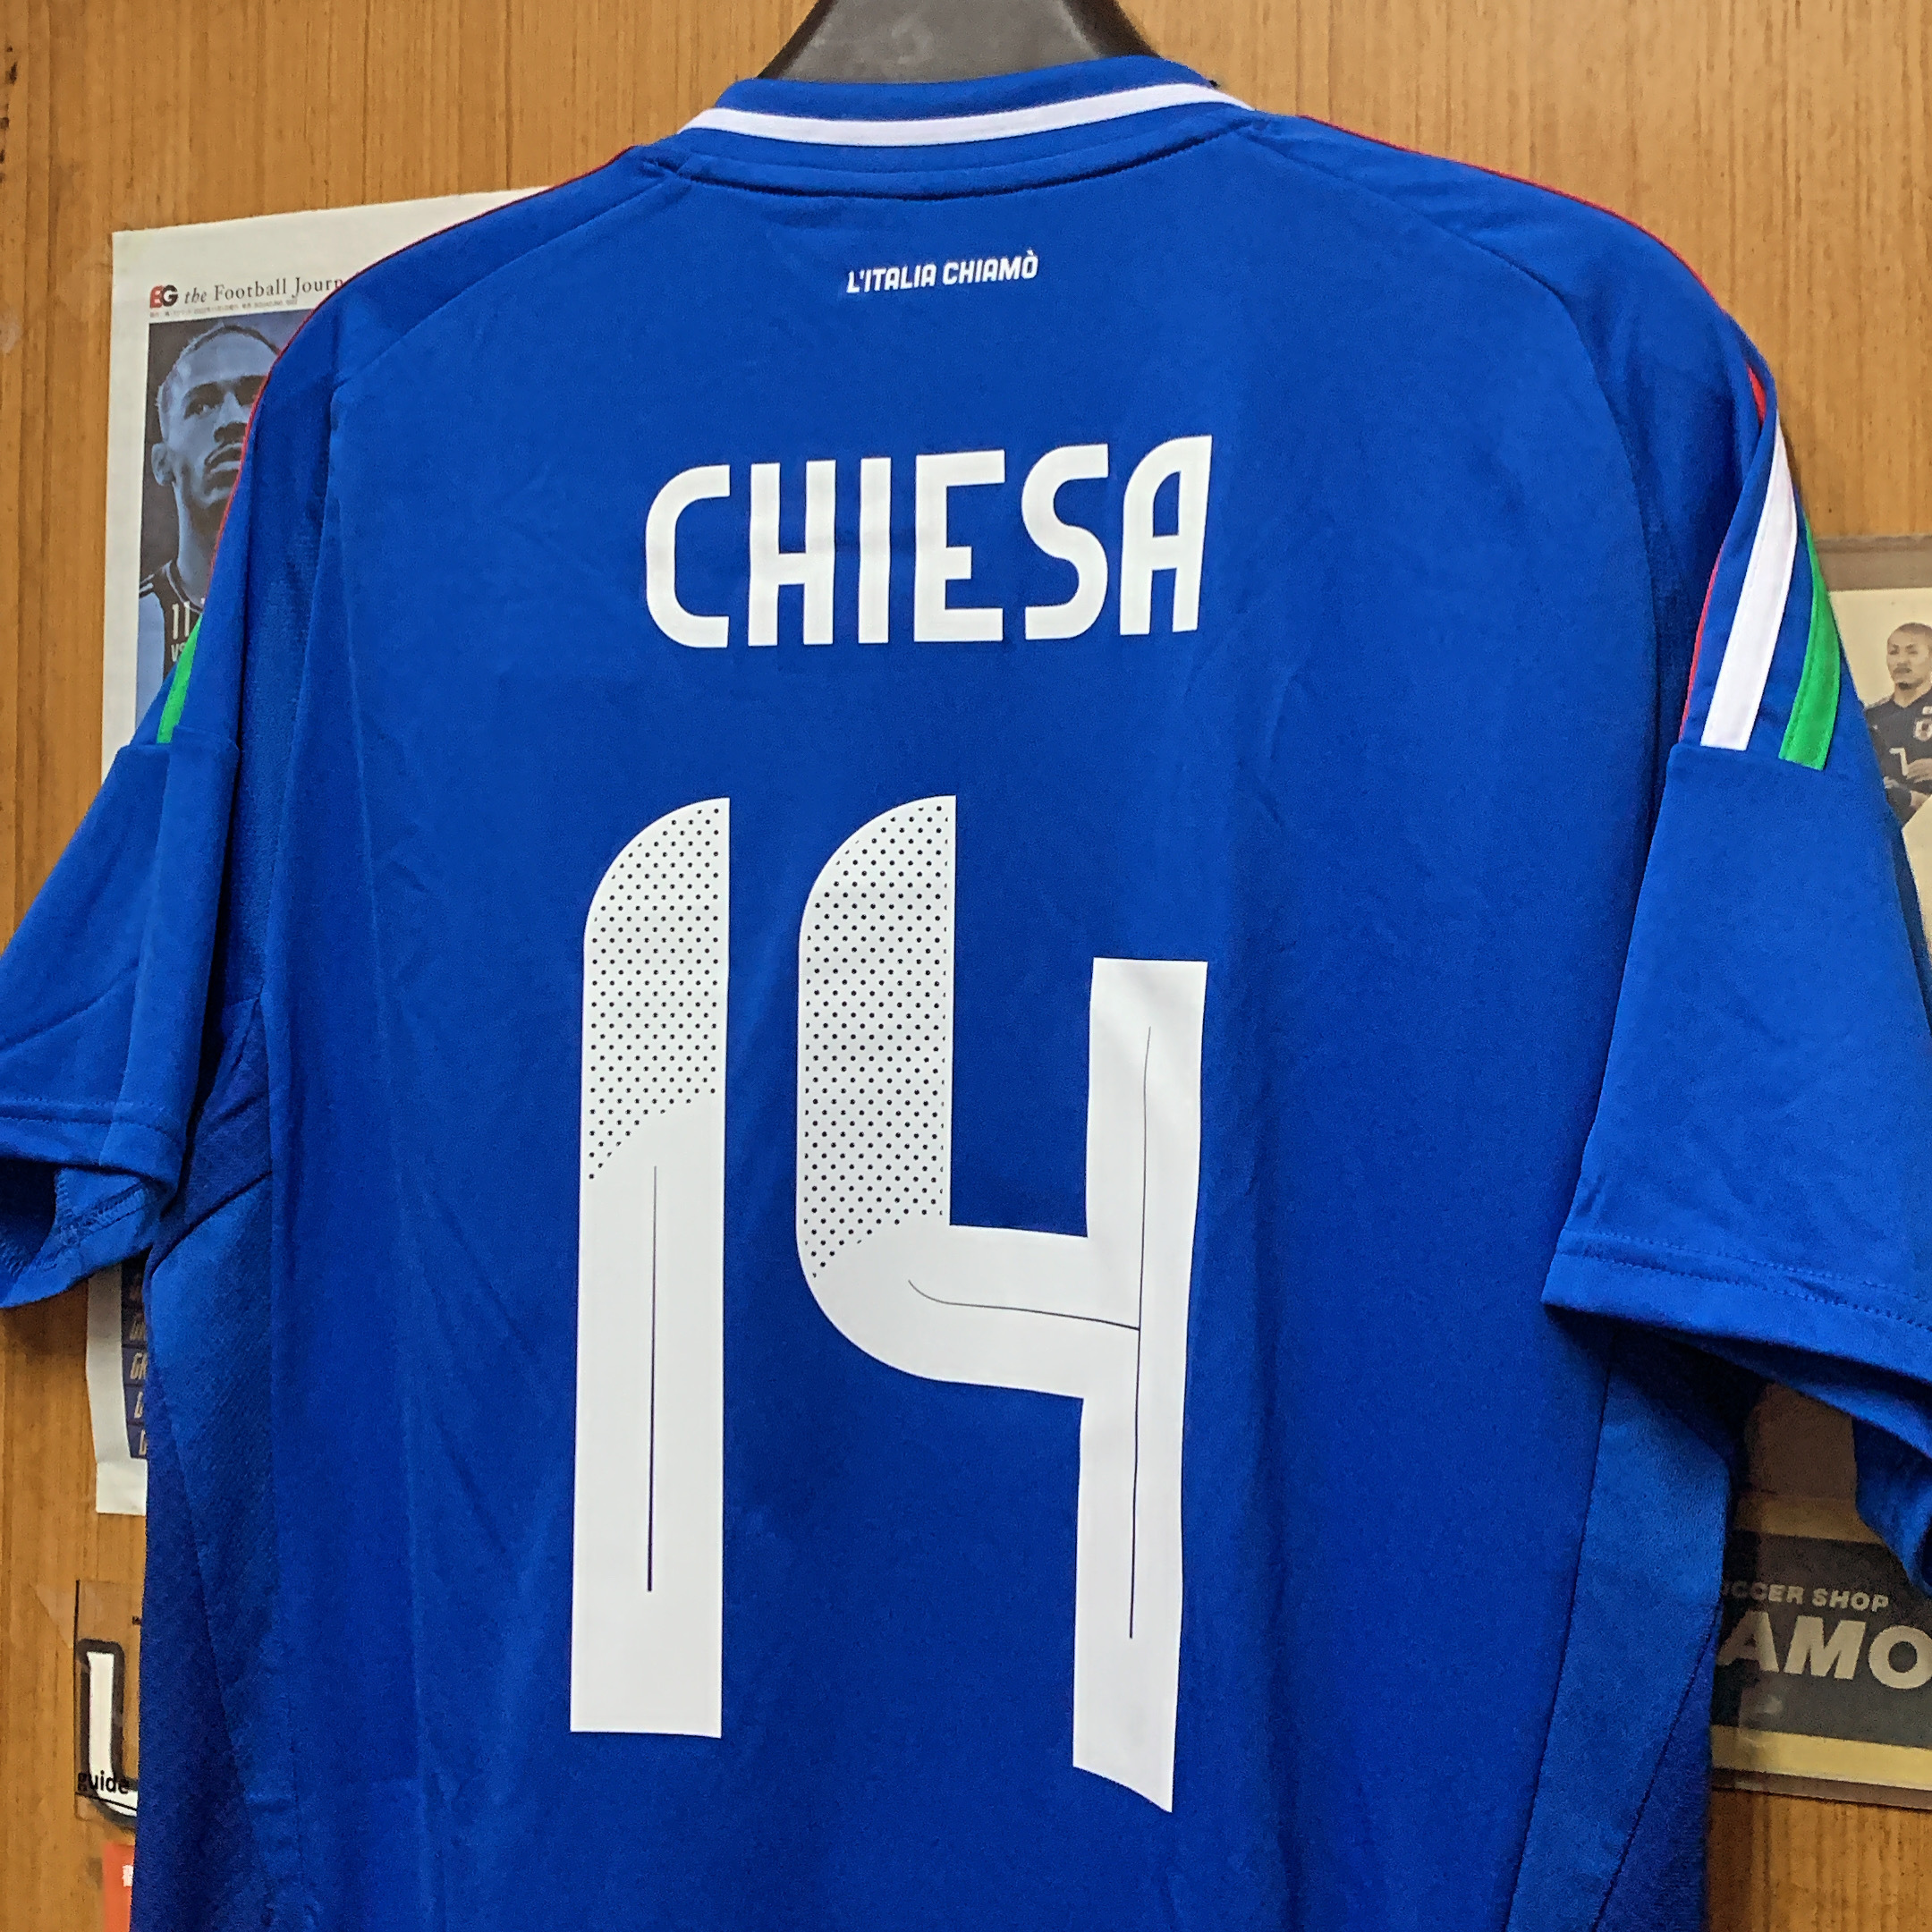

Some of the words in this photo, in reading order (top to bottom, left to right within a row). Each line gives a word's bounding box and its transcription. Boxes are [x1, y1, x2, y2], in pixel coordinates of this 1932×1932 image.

[184, 286, 207, 304] the
[214, 277, 287, 301] Football
[846, 262, 937, 293] L'ITALIA
[942, 248, 1039, 285] CHIAMÒ
[646, 436, 1214, 649] CHIESA
[570, 795, 1208, 1811] 14
[1811, 1588, 1889, 1613] SHOP
[1716, 1610, 1932, 1690] AMO
[77, 1769, 130, 1795] guide
